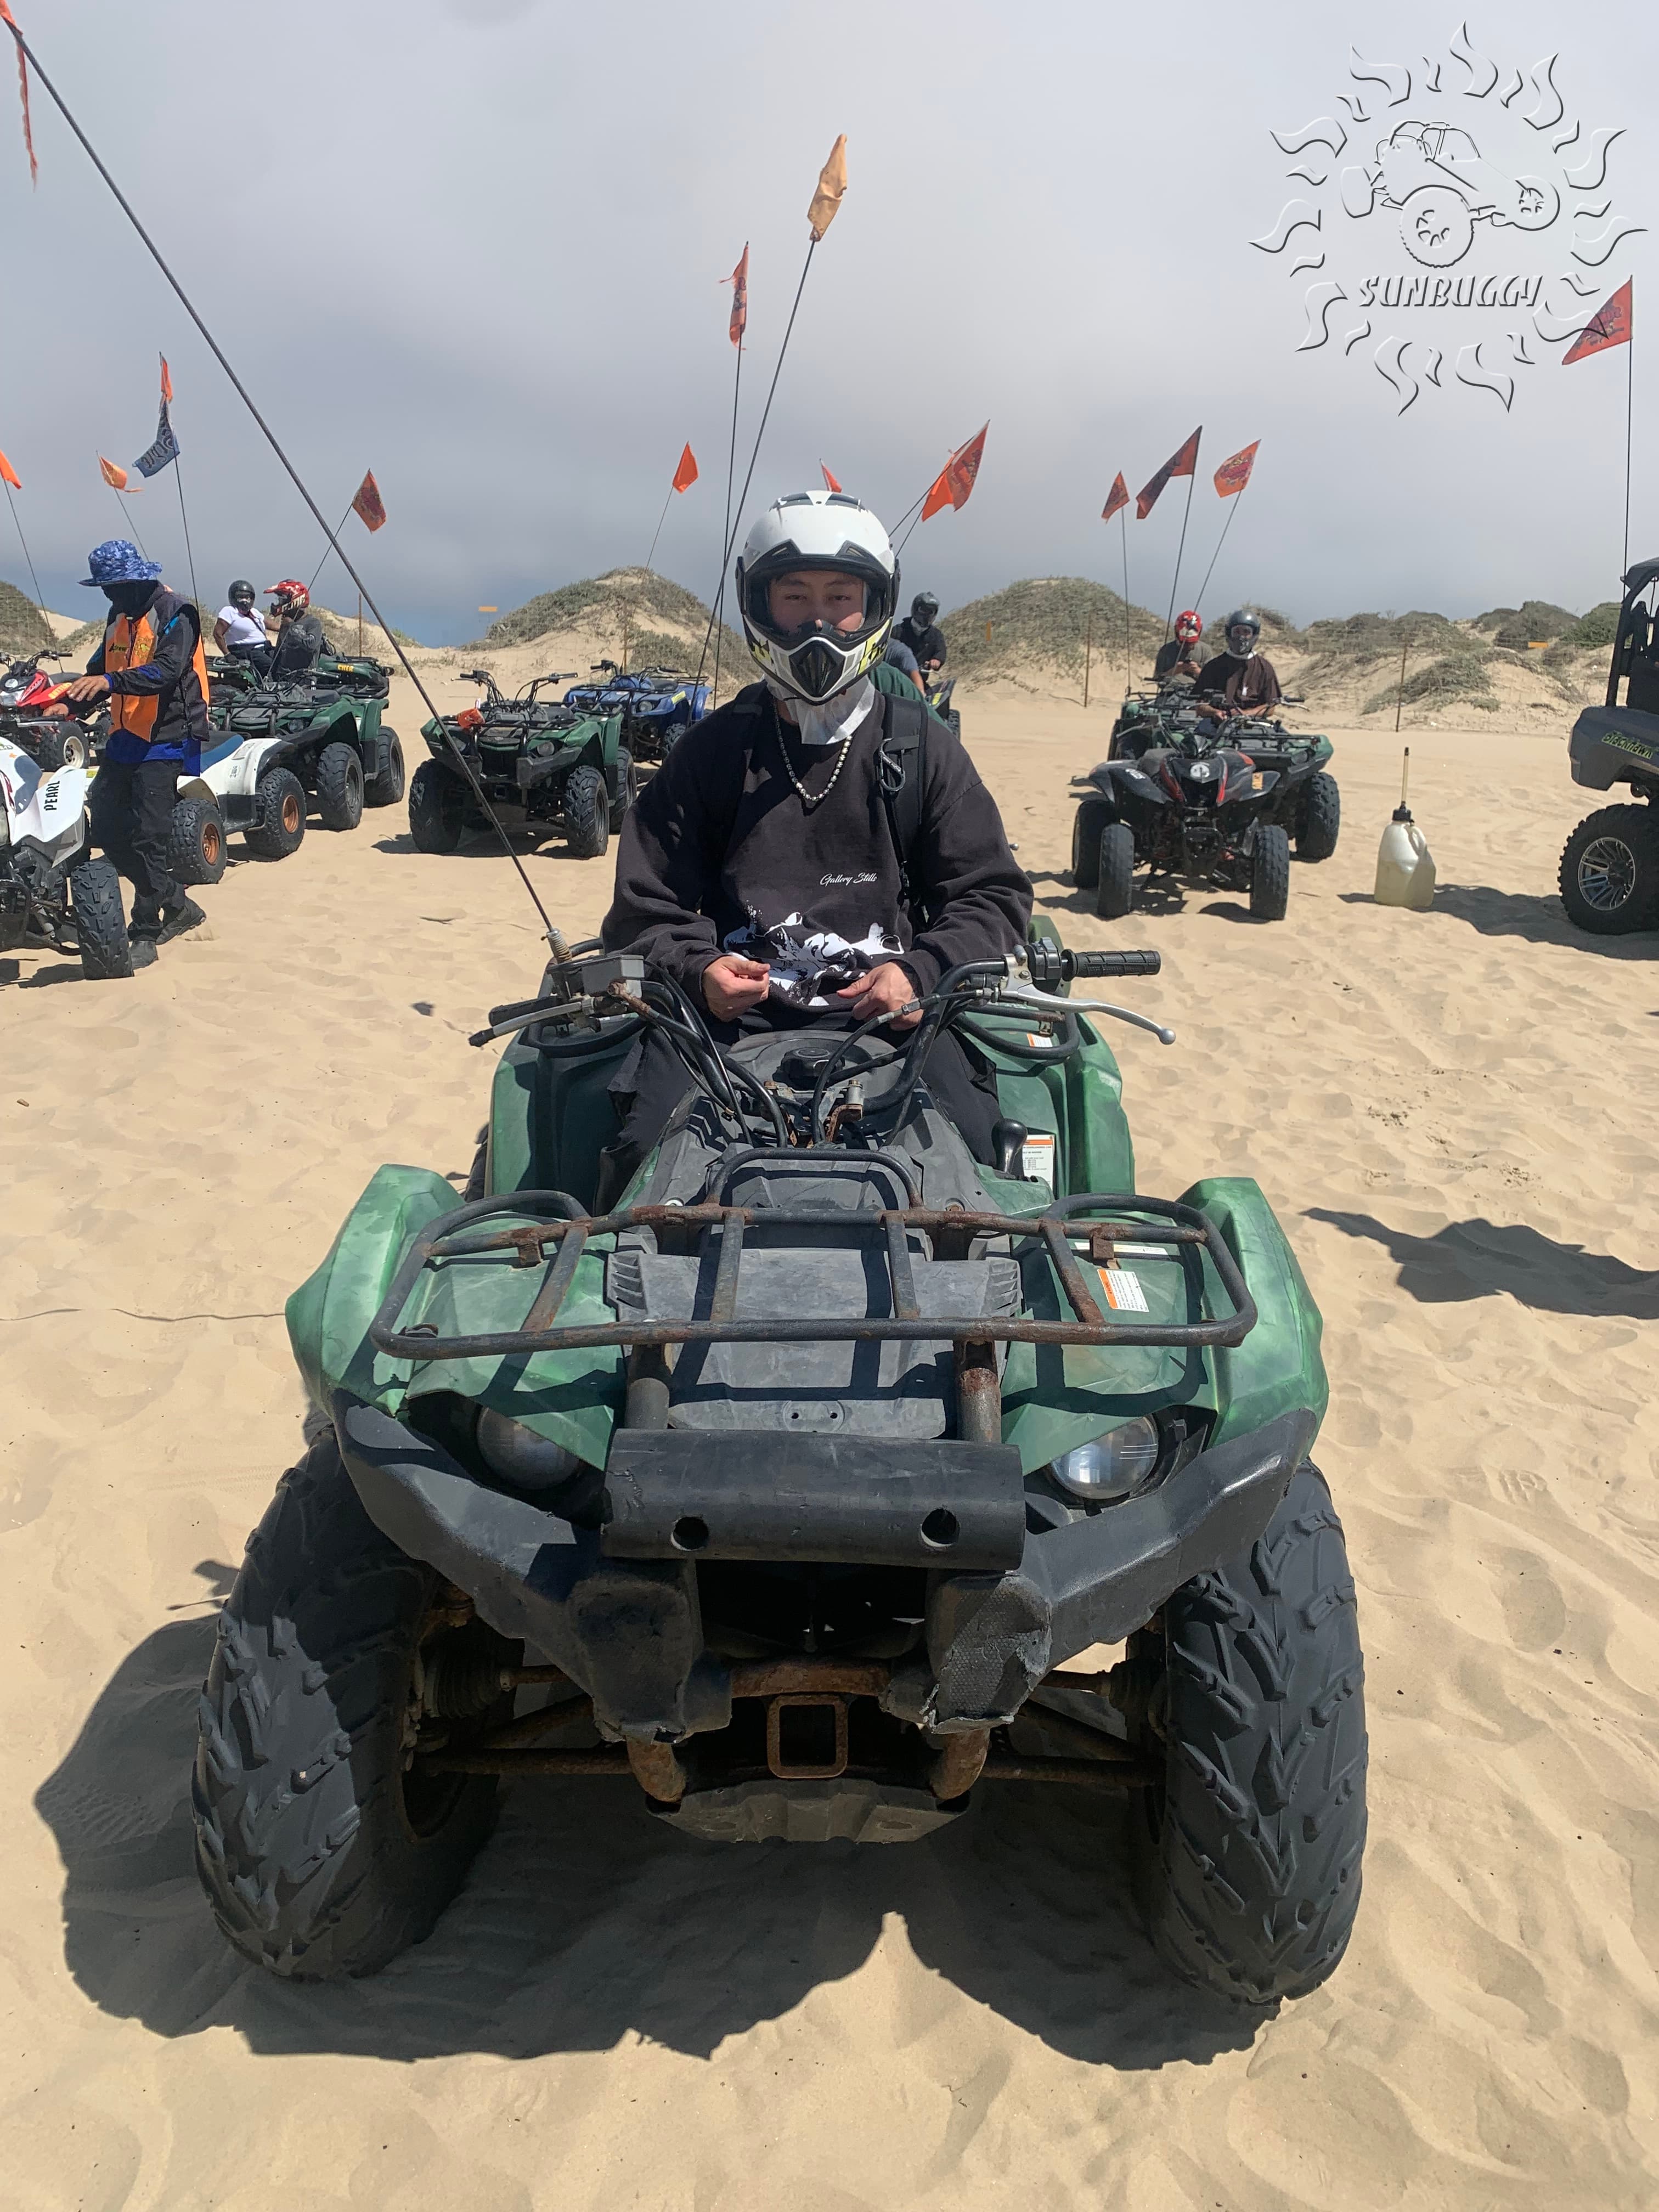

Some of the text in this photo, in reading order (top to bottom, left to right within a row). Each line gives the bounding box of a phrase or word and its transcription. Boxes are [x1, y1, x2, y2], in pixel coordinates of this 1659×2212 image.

[44, 781, 60, 811] PEARL
[820, 872, 877, 887] Gallery Stills
